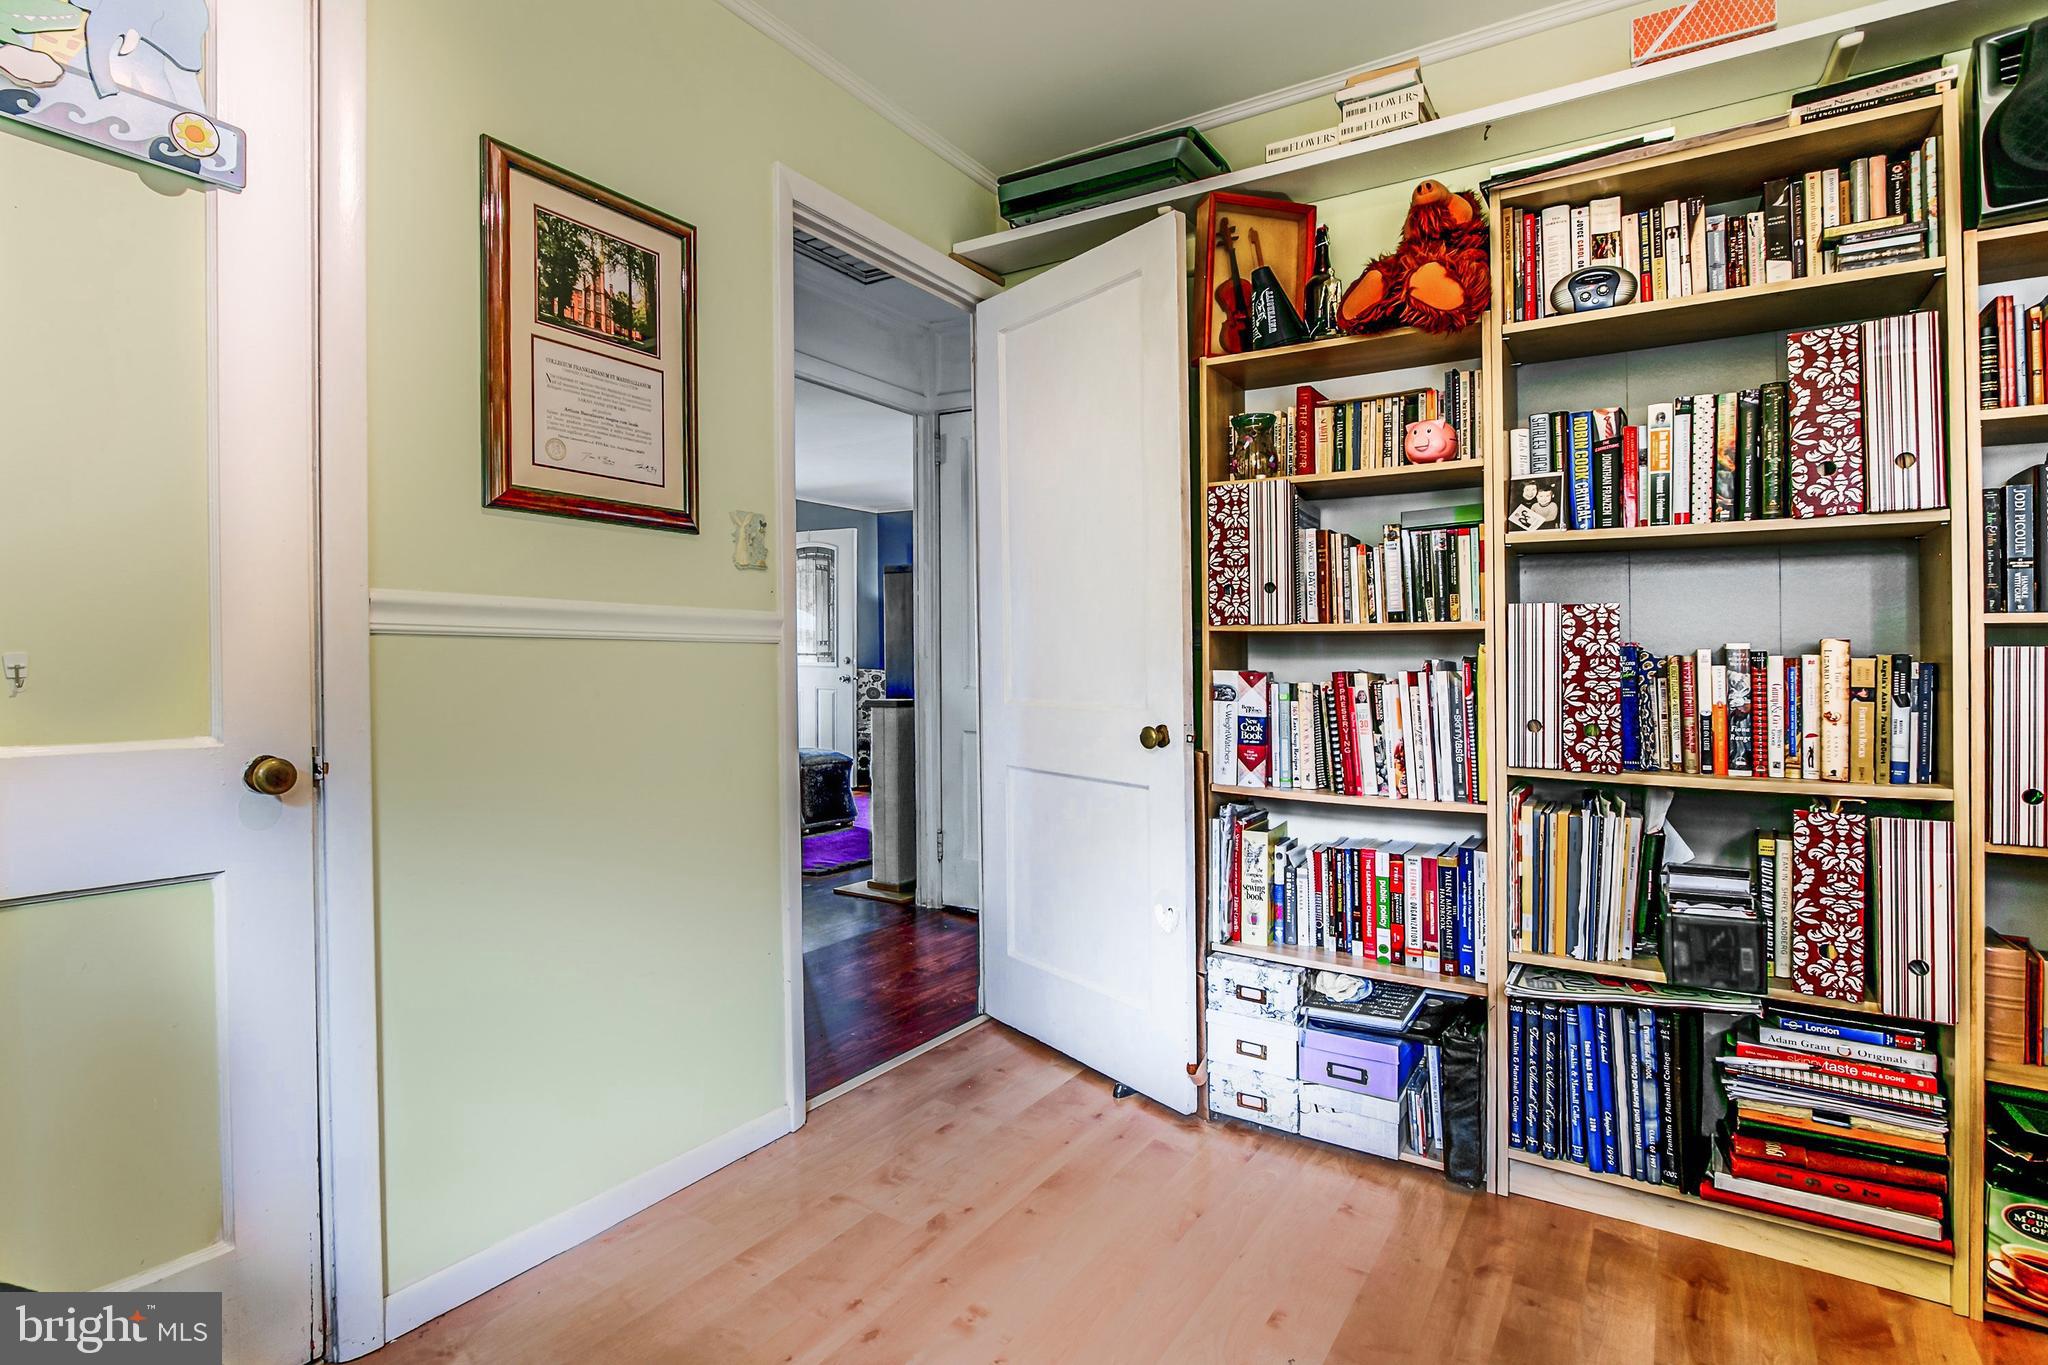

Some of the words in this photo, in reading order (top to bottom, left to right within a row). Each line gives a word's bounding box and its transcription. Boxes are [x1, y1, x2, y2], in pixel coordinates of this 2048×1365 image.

[1368, 91, 1420, 112] FLOWERS
[1818, 105, 1849, 118] ENGLISH
[1850, 100, 1879, 111] PATIENT
[1364, 110, 1414, 130] FLOWERS
[1289, 133, 1336, 152] FLOWERS
[1299, 404, 1308, 425] THE
[1531, 416, 1547, 450] SHIRLEY
[1573, 416, 1588, 449] ROBIN
[1299, 430, 1308, 468] OTHER
[1574, 450, 1588, 480] COOK
[1602, 453, 1612, 485] JONATHAN
[1574, 481, 1591, 522] CRITICAL
[1602, 486, 1612, 515] FRANZEN
[2013, 489, 2026, 511] JODI
[2014, 515, 2026, 555] PICOULT
[1823, 649, 1832, 680] LIZARD
[1824, 682, 1832, 705] CAGE
[1240, 723, 1263, 732] Cook
[1290, 718, 1298, 732] Easy
[1340, 689, 1351, 754] PRESERVING
[1224, 711, 1232, 764] WeightWatchers
[1241, 731, 1262, 740] Book
[1290, 733, 1298, 747] Soup
[1453, 714, 1465, 763] skinnytaste
[1730, 733, 1751, 741] Range
[1762, 860, 1773, 893] QUICK
[1782, 871, 1788, 880] IN
[1243, 885, 1265, 895] sewing
[1246, 891, 1264, 901] book
[1379, 880, 1387, 903] public
[1379, 905, 1388, 927] policy
[1762, 895, 1773, 917] AND
[1410, 902, 1418, 946] ORGANIZATIONS
[1512, 1026, 1520, 1055] Franklin
[1805, 1024, 1840, 1036] London
[1570, 1044, 1578, 1069] Franklin
[1767, 1034, 1798, 1046] Adam
[1800, 1040, 1831, 1052] Grant
[1857, 1049, 1908, 1065] Originals
[1663, 1052, 1671, 1081] College
[1861, 1070, 1876, 1078] ONE
[1884, 1074, 1906, 1084] DONE
[1513, 1064, 1521, 1094] Marshall
[1512, 1096, 1521, 1122] College
[1664, 1082, 1672, 1114] Marshall
[1570, 1105, 1579, 1126] College
[1666, 1125, 1674, 1156] Franklin
[1606, 1145, 1614, 1166] 1999
